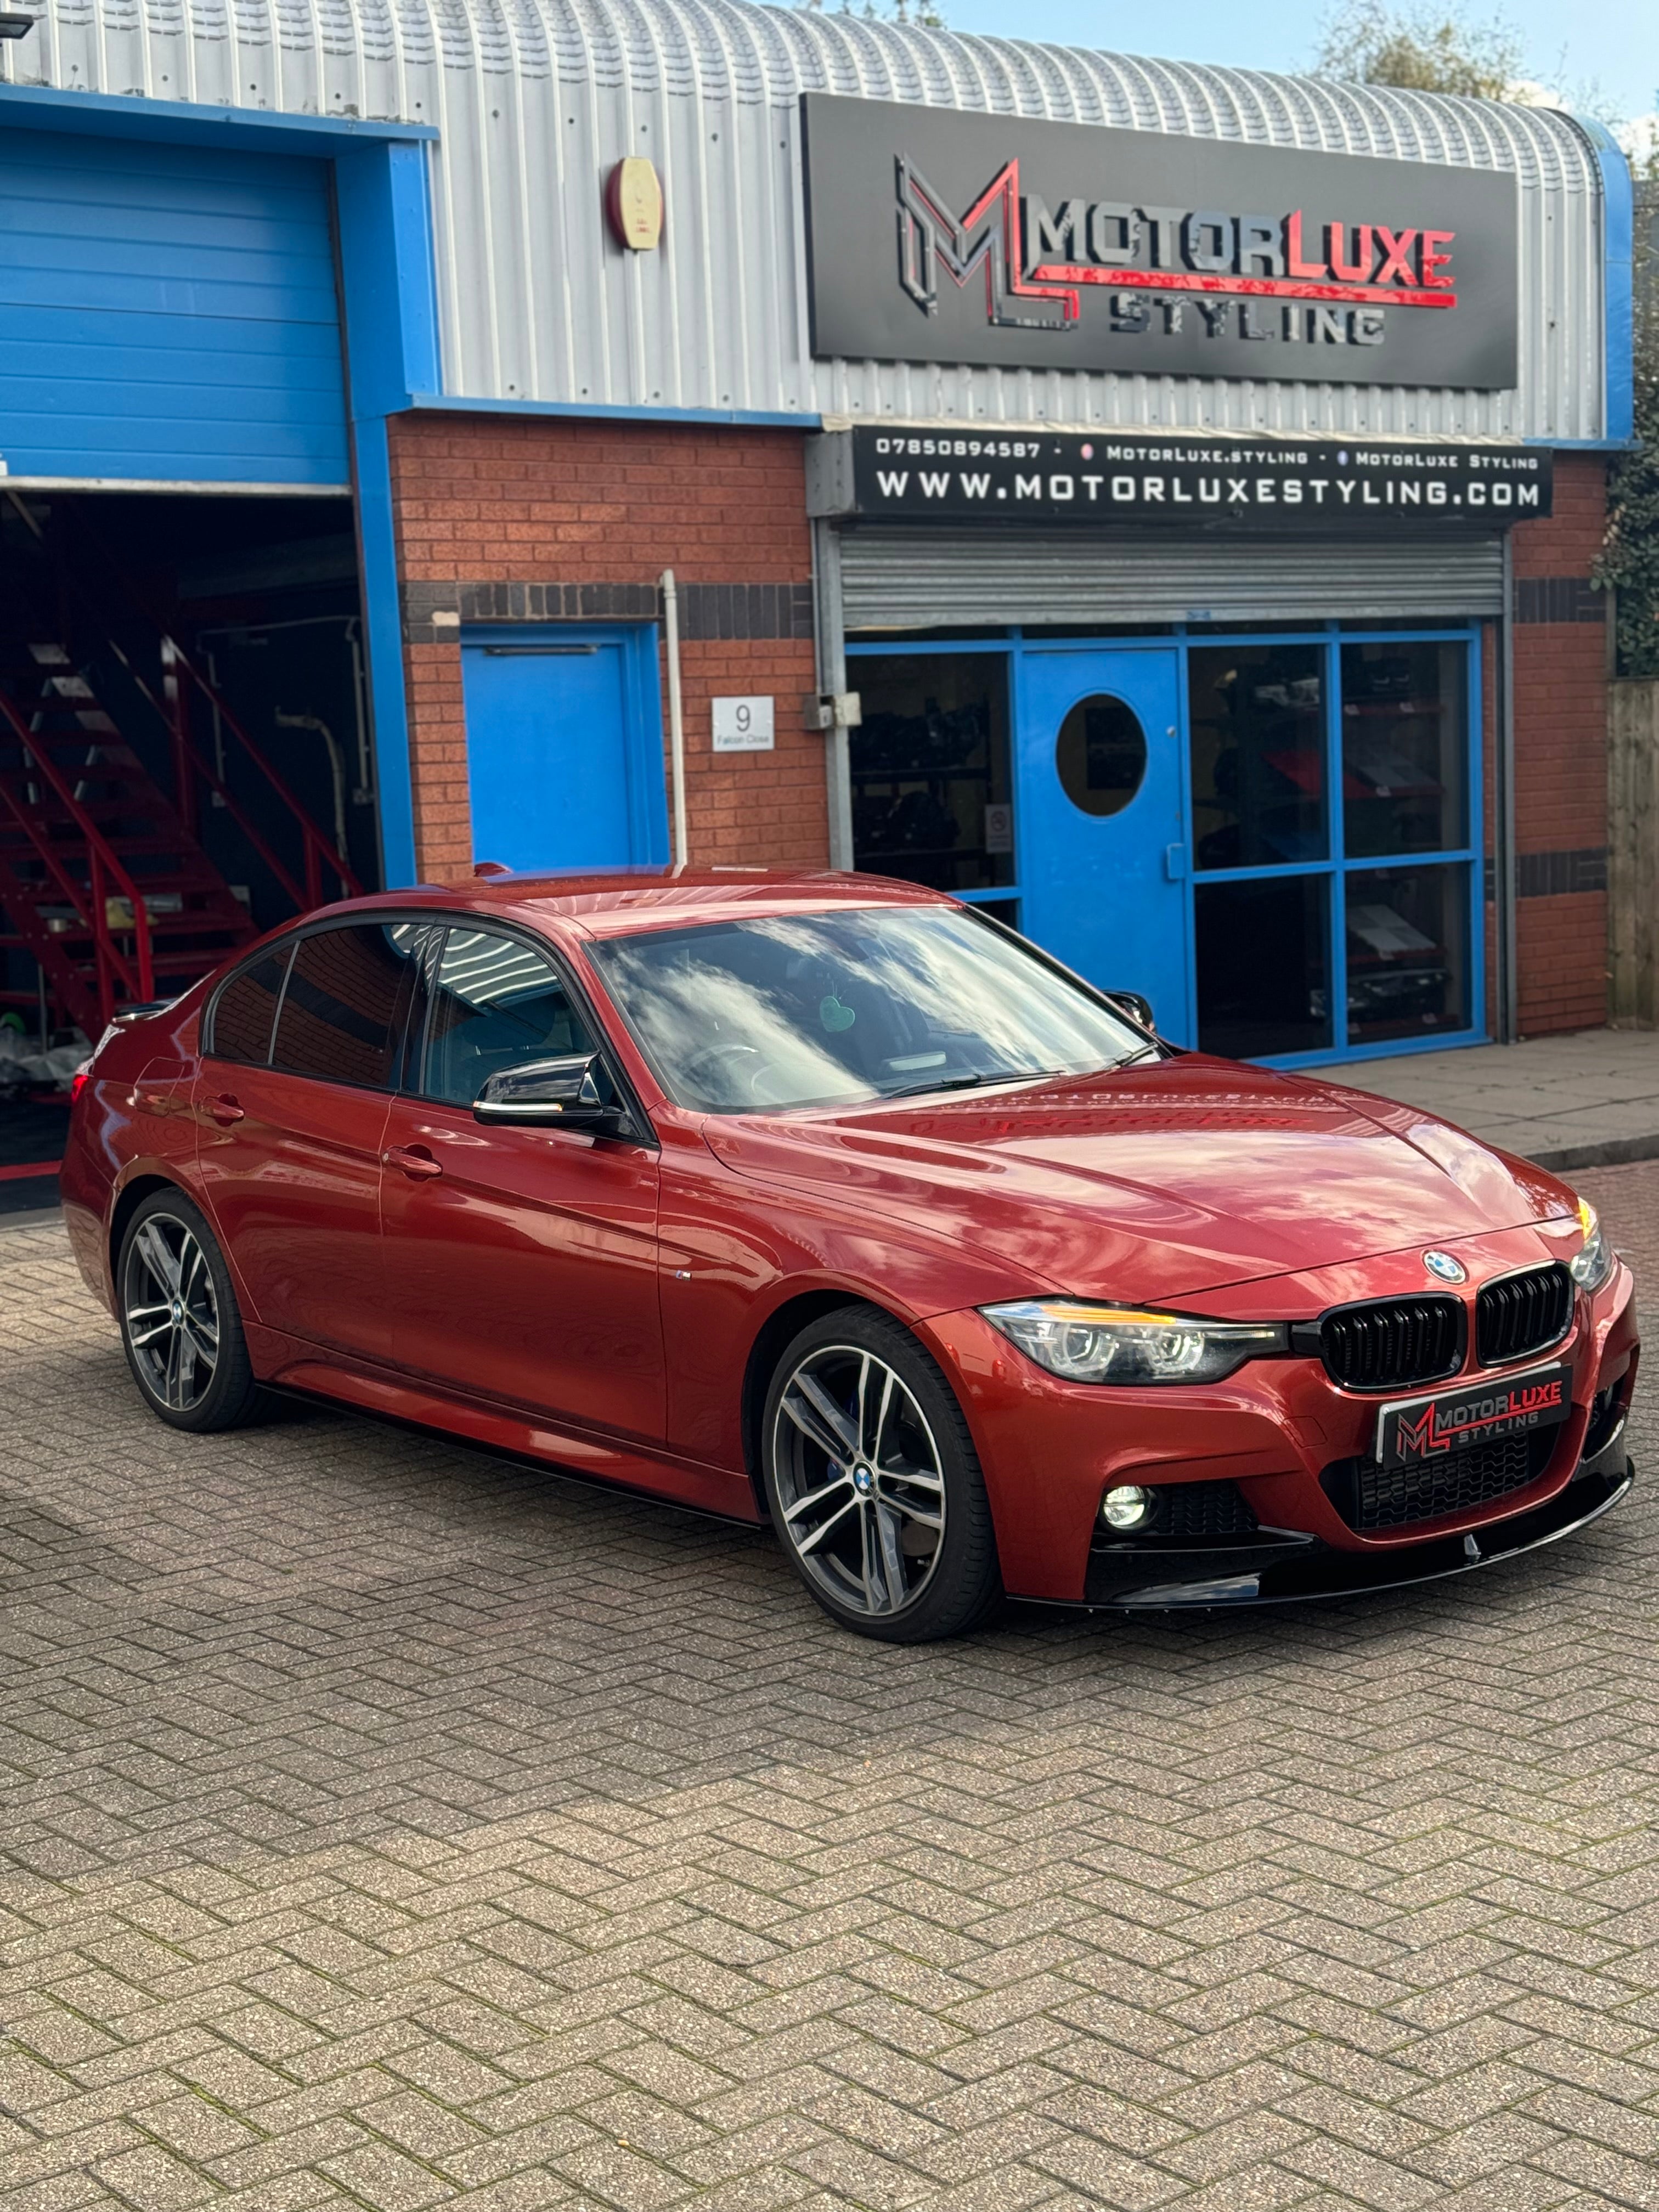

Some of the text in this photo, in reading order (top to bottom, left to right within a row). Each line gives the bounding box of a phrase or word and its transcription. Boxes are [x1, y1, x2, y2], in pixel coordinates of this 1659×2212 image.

[1022, 194, 1456, 290] MOTORLUXE
[1112, 292, 1385, 346] STYLING
[876, 438, 1040, 458] 07850894587
[876, 471, 1538, 505] WWW.MOTORLUXESTYLING.COM
[736, 704, 751, 732] 9
[1436, 1380, 1562, 1434] MOTORLUXE
[1458, 1411, 1539, 1444] STYLING
